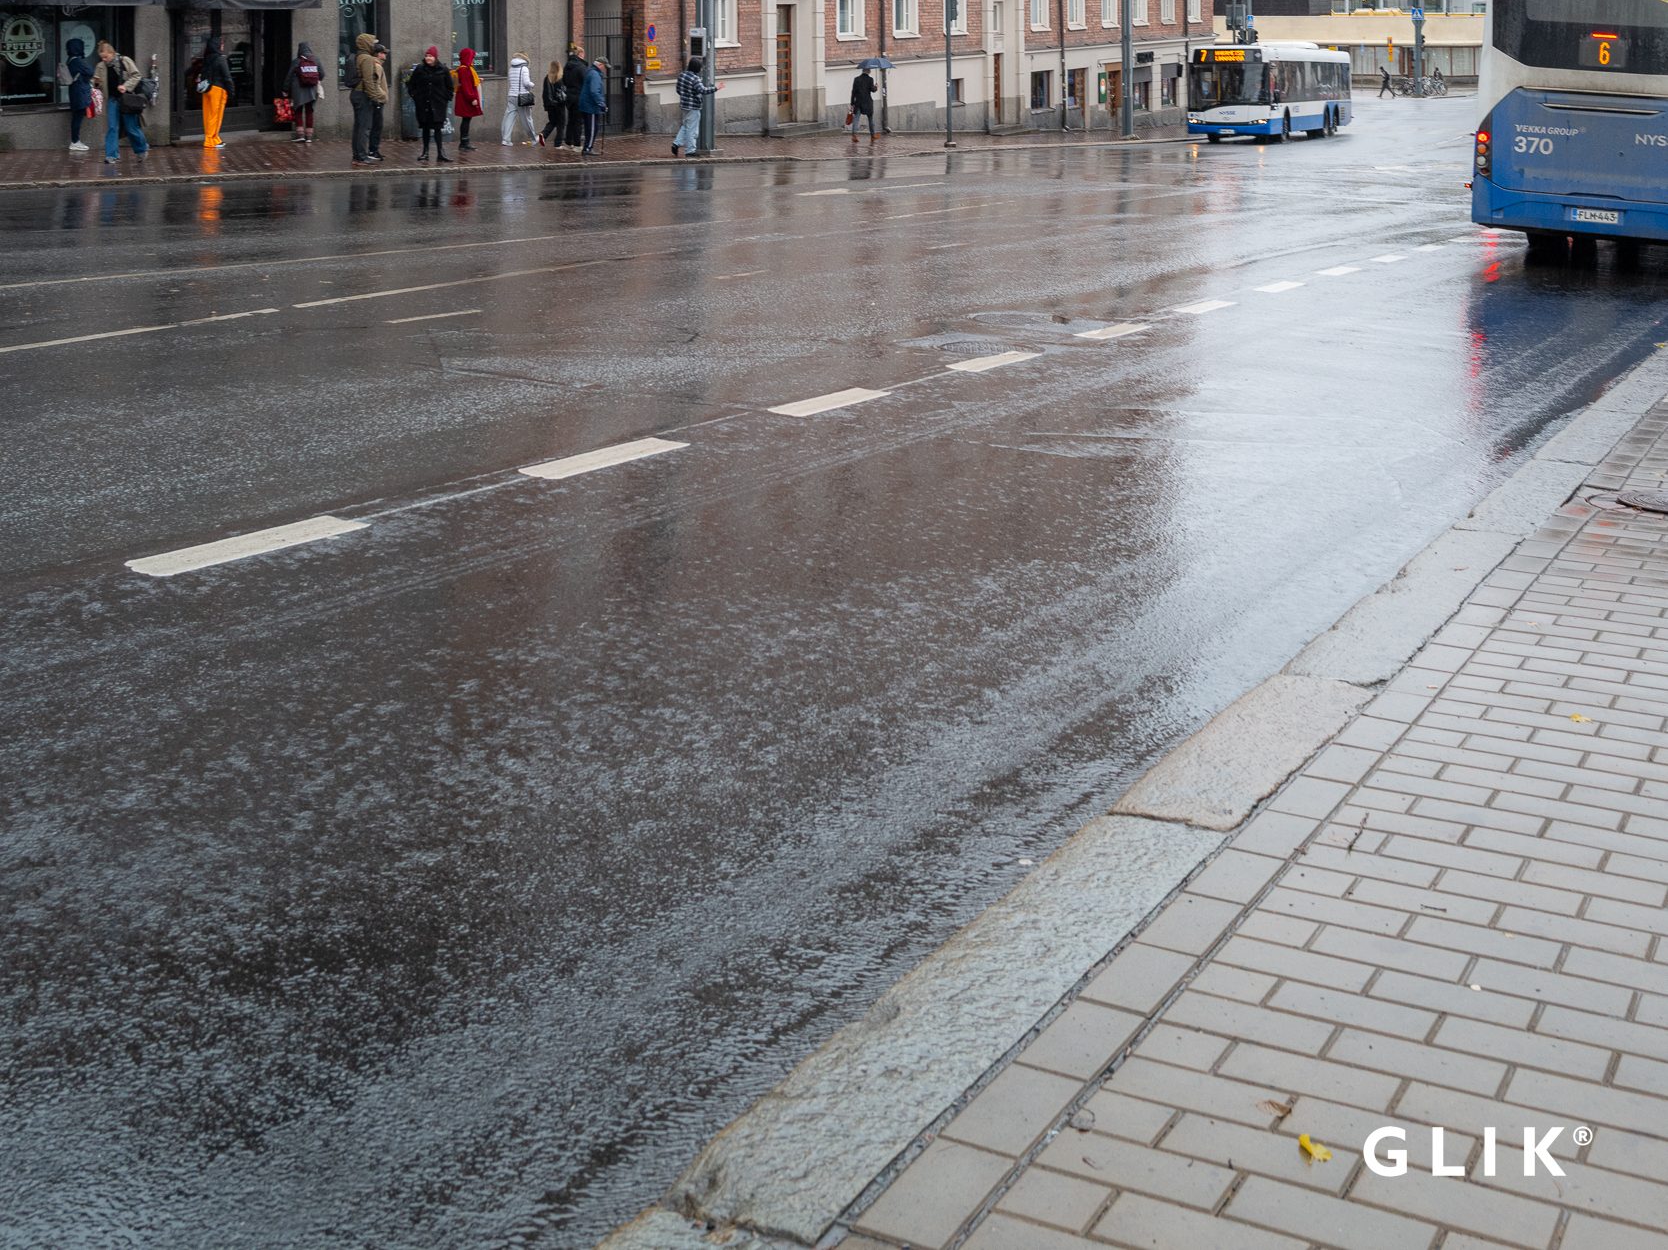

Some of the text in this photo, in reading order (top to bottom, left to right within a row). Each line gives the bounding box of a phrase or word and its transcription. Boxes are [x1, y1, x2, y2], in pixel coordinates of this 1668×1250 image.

[5, 42, 38, 50] PUTKA
[1200, 49, 1207, 62] 7
[1599, 41, 1611, 65] 6
[1514, 124, 1579, 136] VEKKA GROUP
[1513, 136, 1554, 155] 370
[1635, 133, 1668, 147] NYS
[1577, 210, 1617, 222] FLM-443
